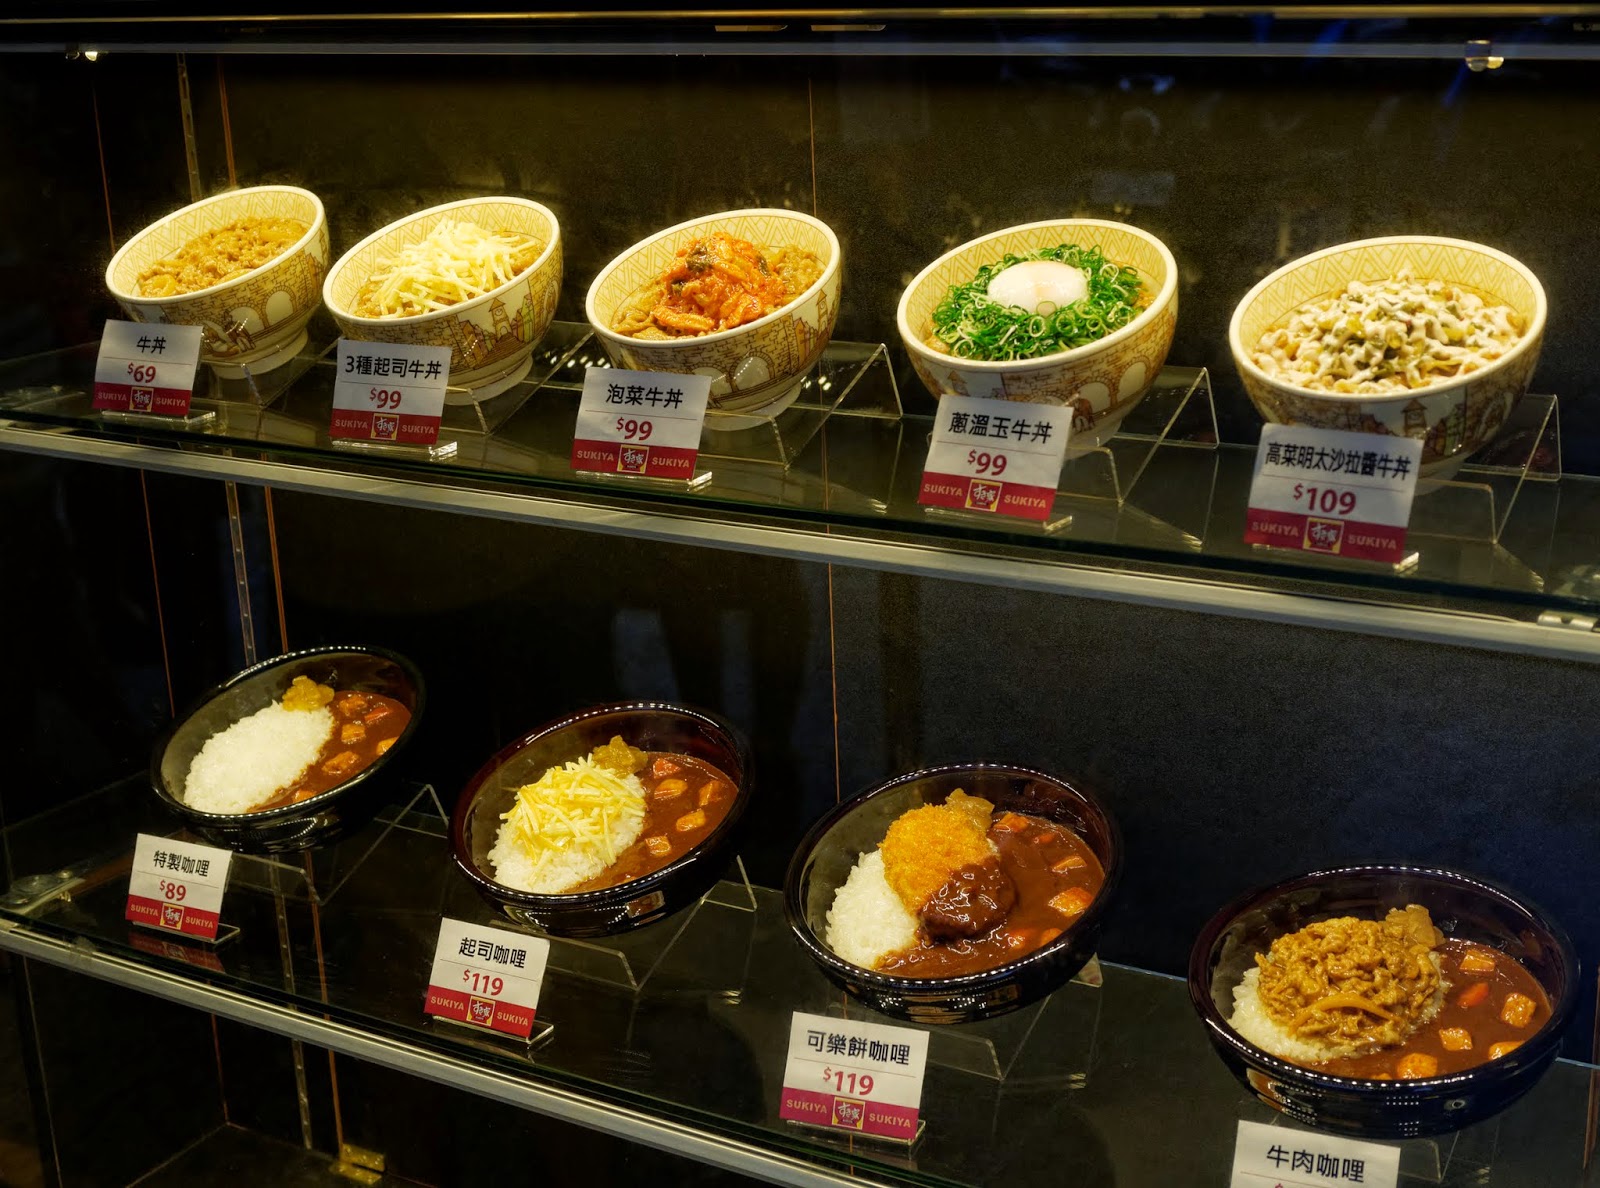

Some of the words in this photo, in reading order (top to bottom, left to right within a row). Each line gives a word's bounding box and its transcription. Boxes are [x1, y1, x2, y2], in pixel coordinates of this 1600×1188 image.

[136, 335, 166, 354] 牛丼
[128, 362, 156, 383] $69
[345, 355, 442, 380] 3種起司牛丼
[98, 392, 127, 401] SUKIYA
[156, 396, 186, 407] SUKIYA
[369, 387, 402, 410] $99
[606, 384, 683, 409] 泡菜牛丼
[335, 420, 368, 429] SUKIYA
[402, 424, 435, 434] SUKIYA
[616, 417, 653, 441] $99
[577, 450, 614, 461] SUKIYA
[652, 457, 690, 468] SUKIYA
[967, 449, 1007, 476] $99
[1265, 442, 1411, 480] 高菜明太沙拉醬牛丼
[924, 483, 963, 496] SUKIYA
[1004, 494, 1046, 508] SUKIYA
[1293, 483, 1356, 515] $109
[1252, 522, 1299, 537] SUKIYA
[1348, 534, 1397, 549] SUKIYA
[153, 850, 210, 877] 特製咖哩
[160, 880, 187, 901] $89
[130, 904, 159, 917] SUKIYA
[185, 916, 213, 928] SUKIYA
[458, 937, 526, 969] 起司咖哩
[463, 969, 504, 996] $119
[431, 997, 464, 1010] SUKIYA
[497, 1012, 528, 1026] SUKIYA
[807, 1030, 910, 1066] 可樂餅咖哩
[823, 1066, 874, 1096] $119
[786, 1099, 827, 1114] SUKIYA
[869, 1113, 911, 1128] SUKIYA
[1266, 1145, 1365, 1183] 牛肉咖哩
